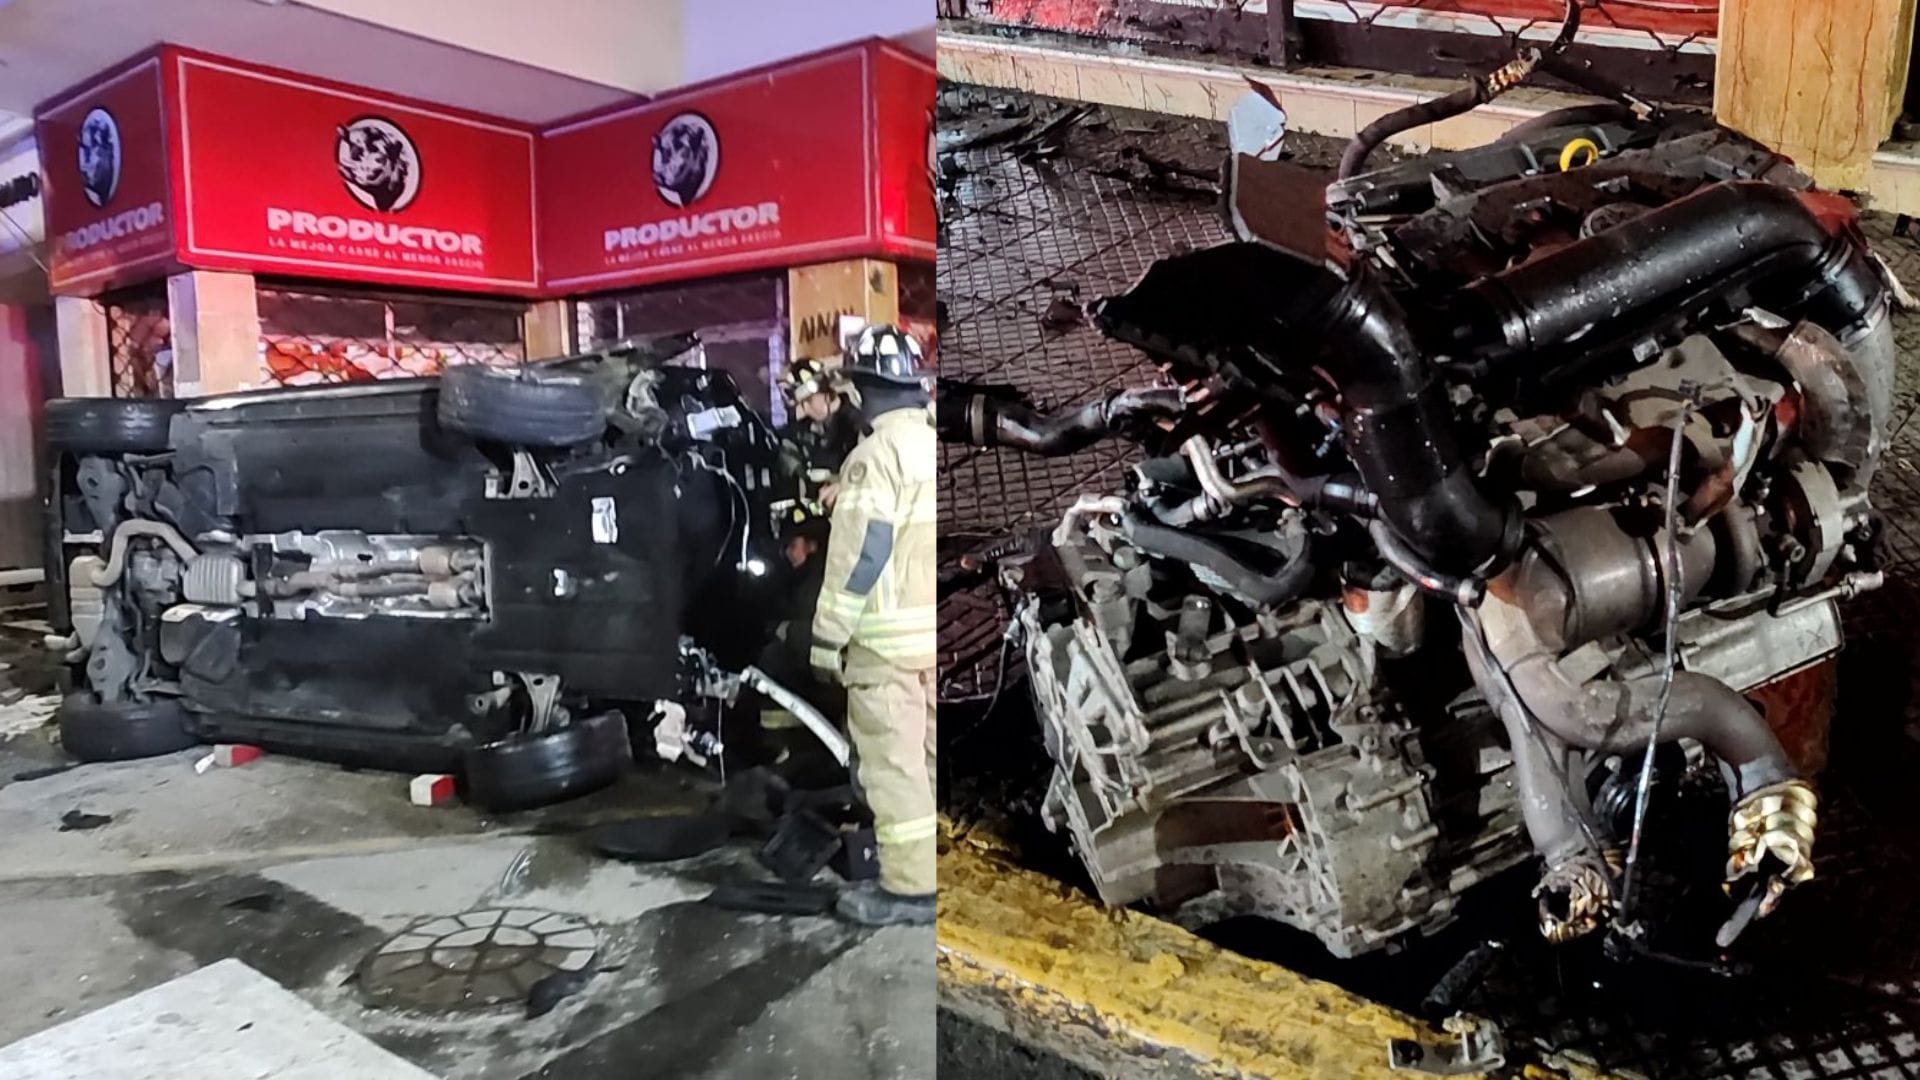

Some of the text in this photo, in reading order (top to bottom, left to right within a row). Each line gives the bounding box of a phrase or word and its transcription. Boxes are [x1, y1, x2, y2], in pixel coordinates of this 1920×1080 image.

[266, 207, 483, 255] PRODUCTOR
[268, 235, 286, 248] LA
[289, 238, 335, 253] MEJOR
[604, 202, 781, 251] PRODUCTOR
